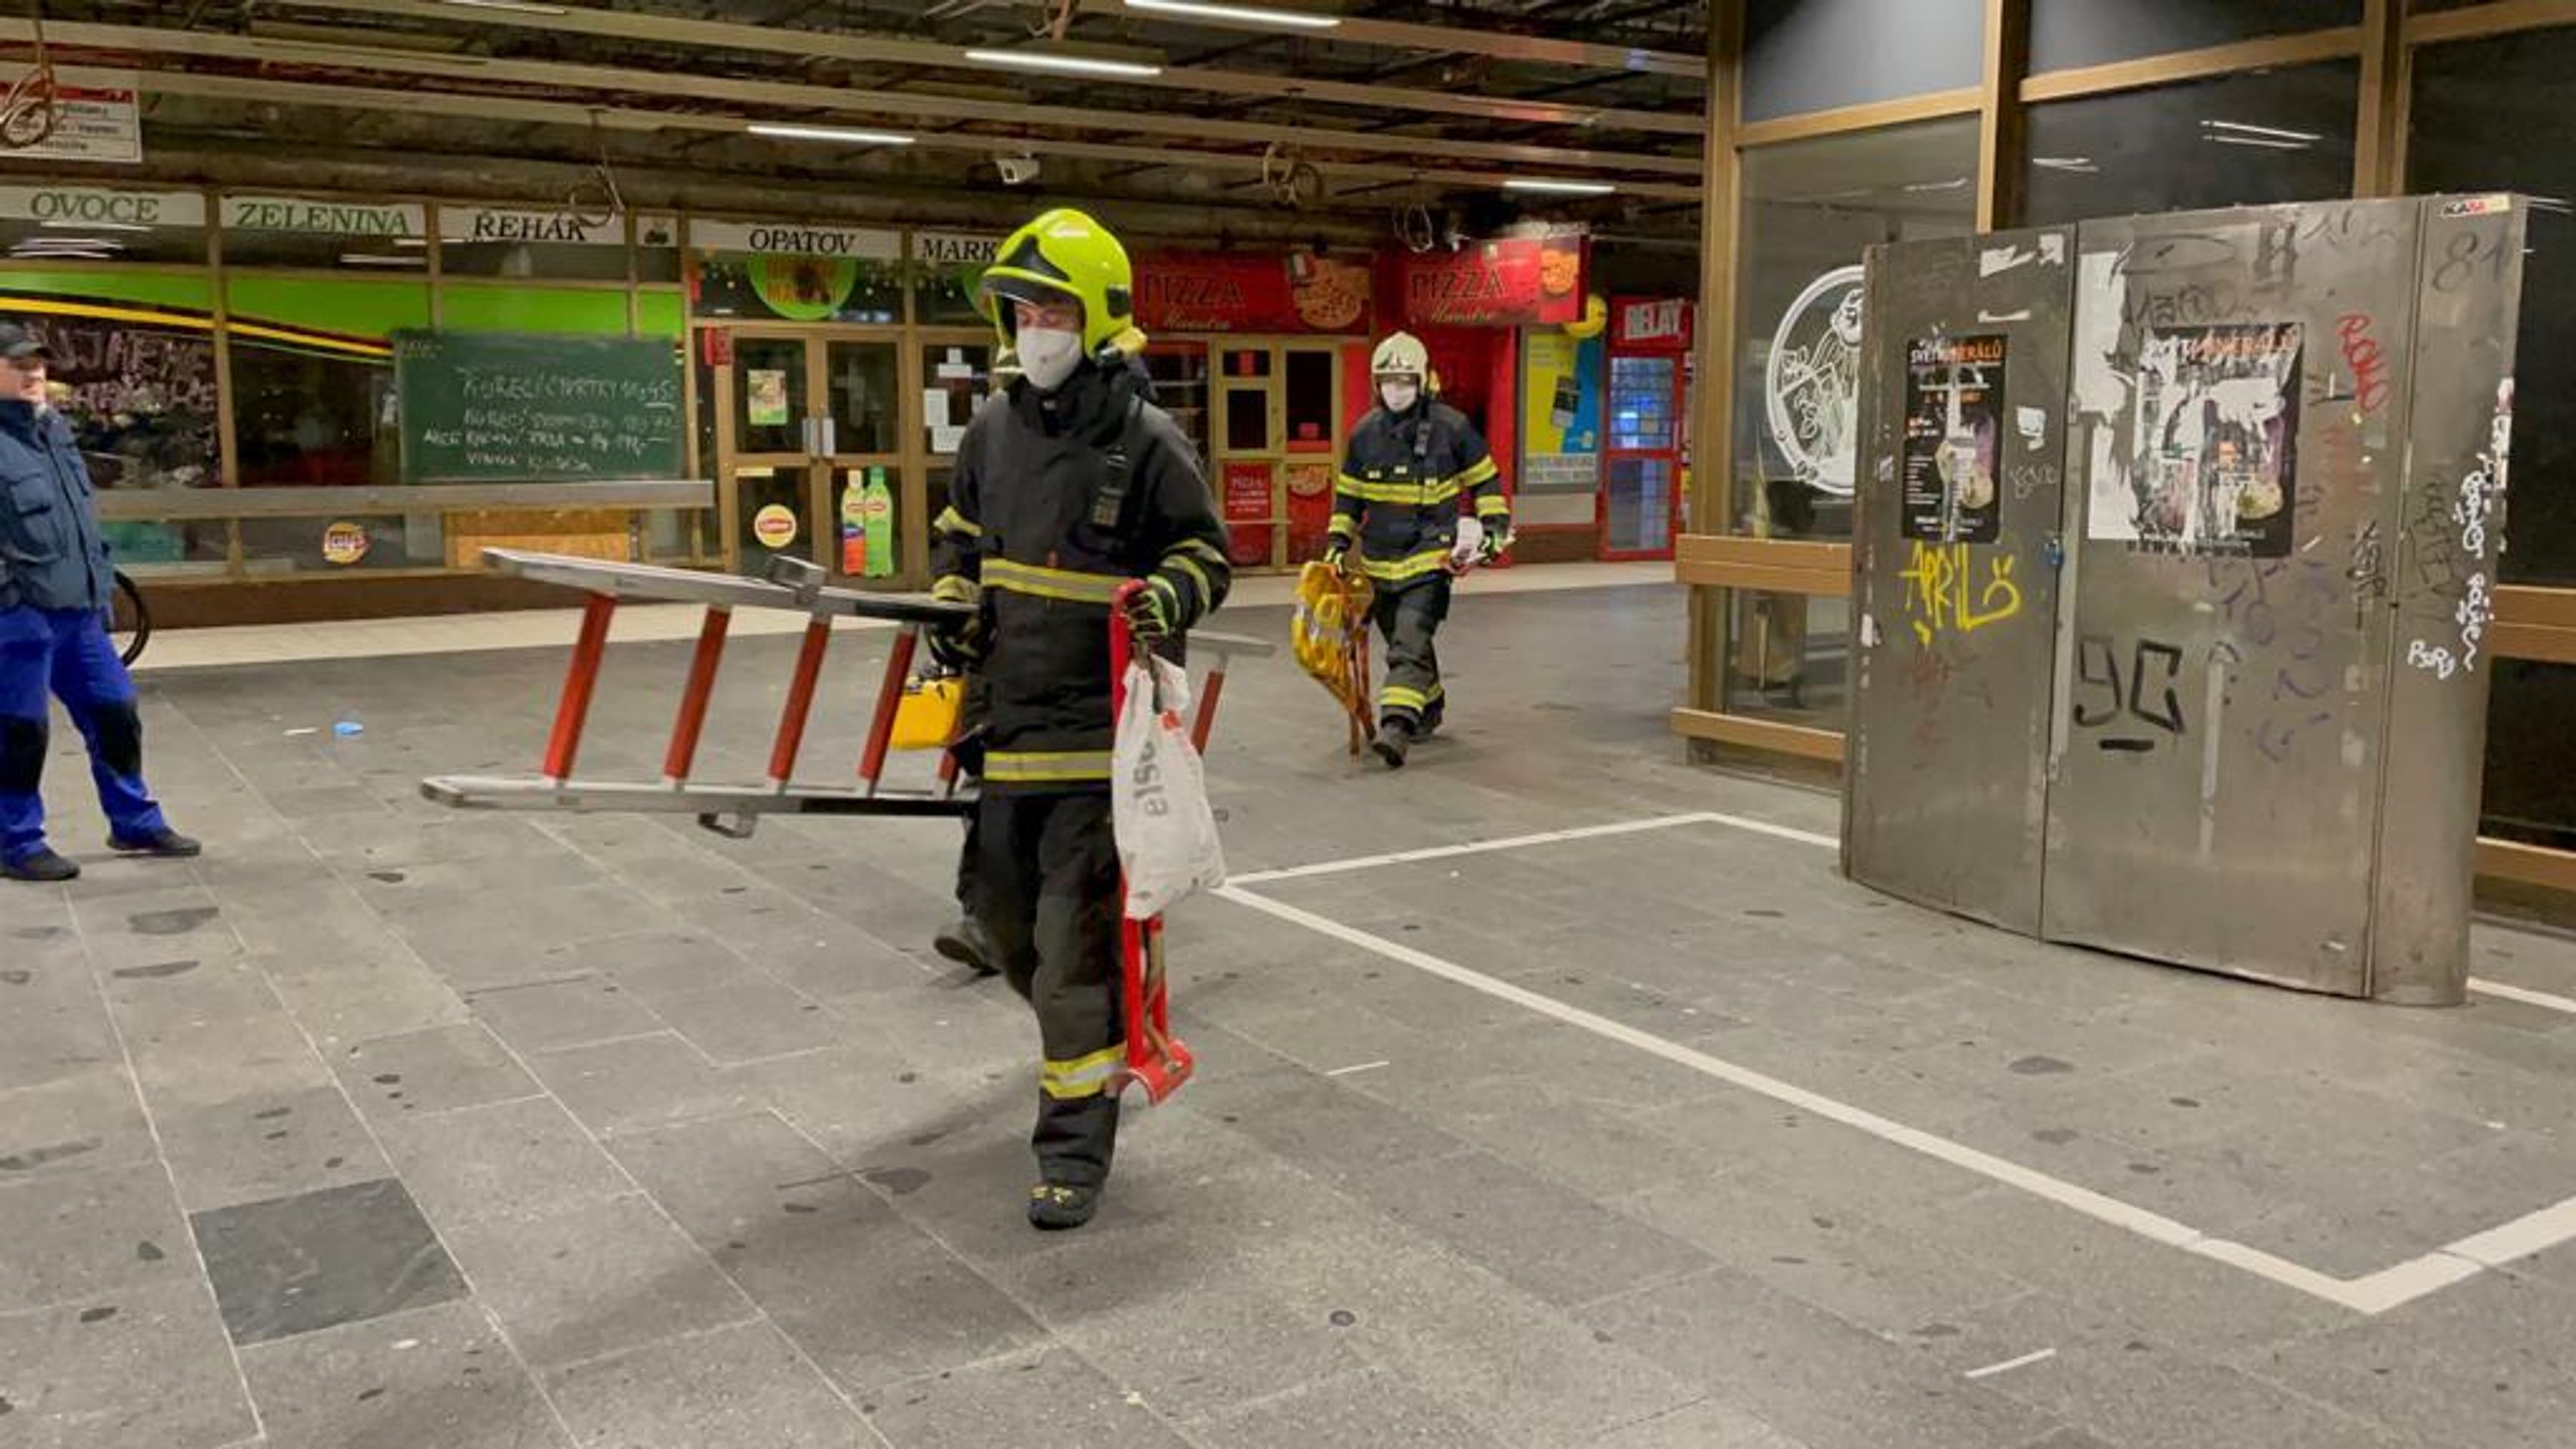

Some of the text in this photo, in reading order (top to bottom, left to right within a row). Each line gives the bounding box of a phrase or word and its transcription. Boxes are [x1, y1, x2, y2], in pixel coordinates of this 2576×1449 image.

[31, 192, 159, 223] OVOCE
[236, 202, 410, 235] ZELENINA
[749, 229, 856, 254] OPATOV
[1145, 275, 1245, 305] PIZZA
[1412, 269, 1504, 300] PIZZA
